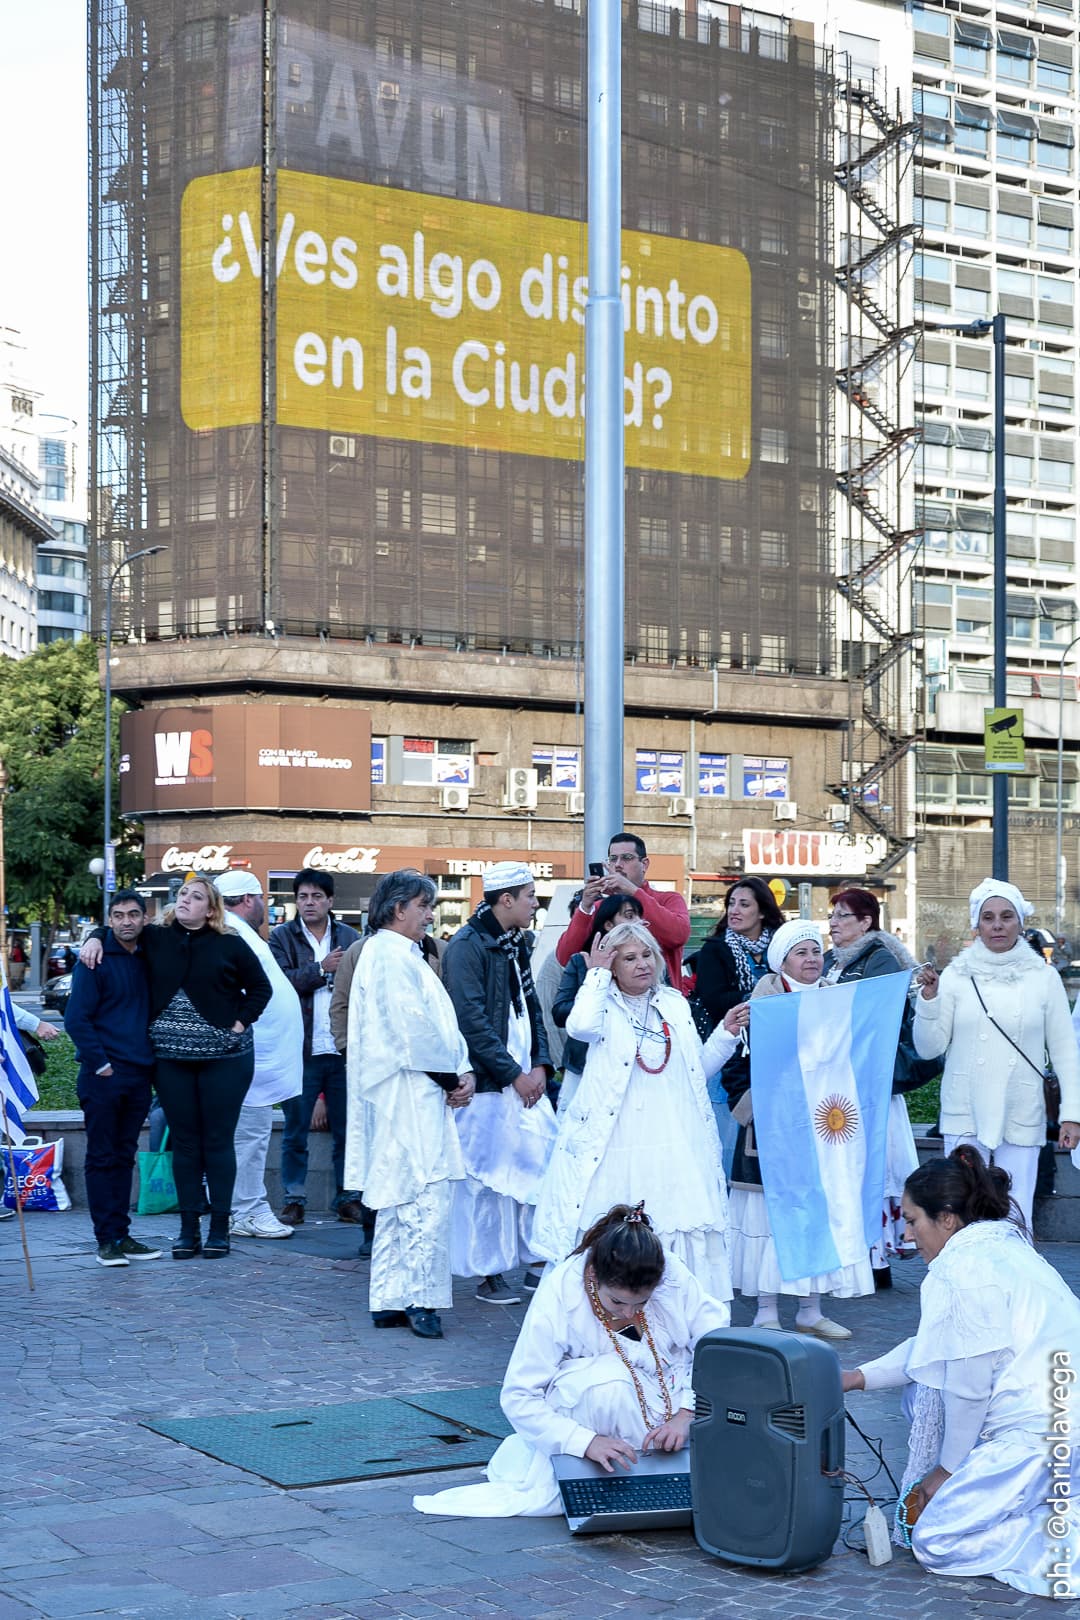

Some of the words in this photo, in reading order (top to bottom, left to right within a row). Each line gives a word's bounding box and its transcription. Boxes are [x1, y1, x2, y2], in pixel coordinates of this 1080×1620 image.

[211, 210, 359, 290] ¿Ves
[377, 231, 502, 320] algo
[519, 254, 719, 345] disinto
[293, 331, 364, 392] en
[386, 325, 432, 400] la
[452, 340, 672, 430] Ciudd?
[7, 1174, 47, 1189] DEGO
